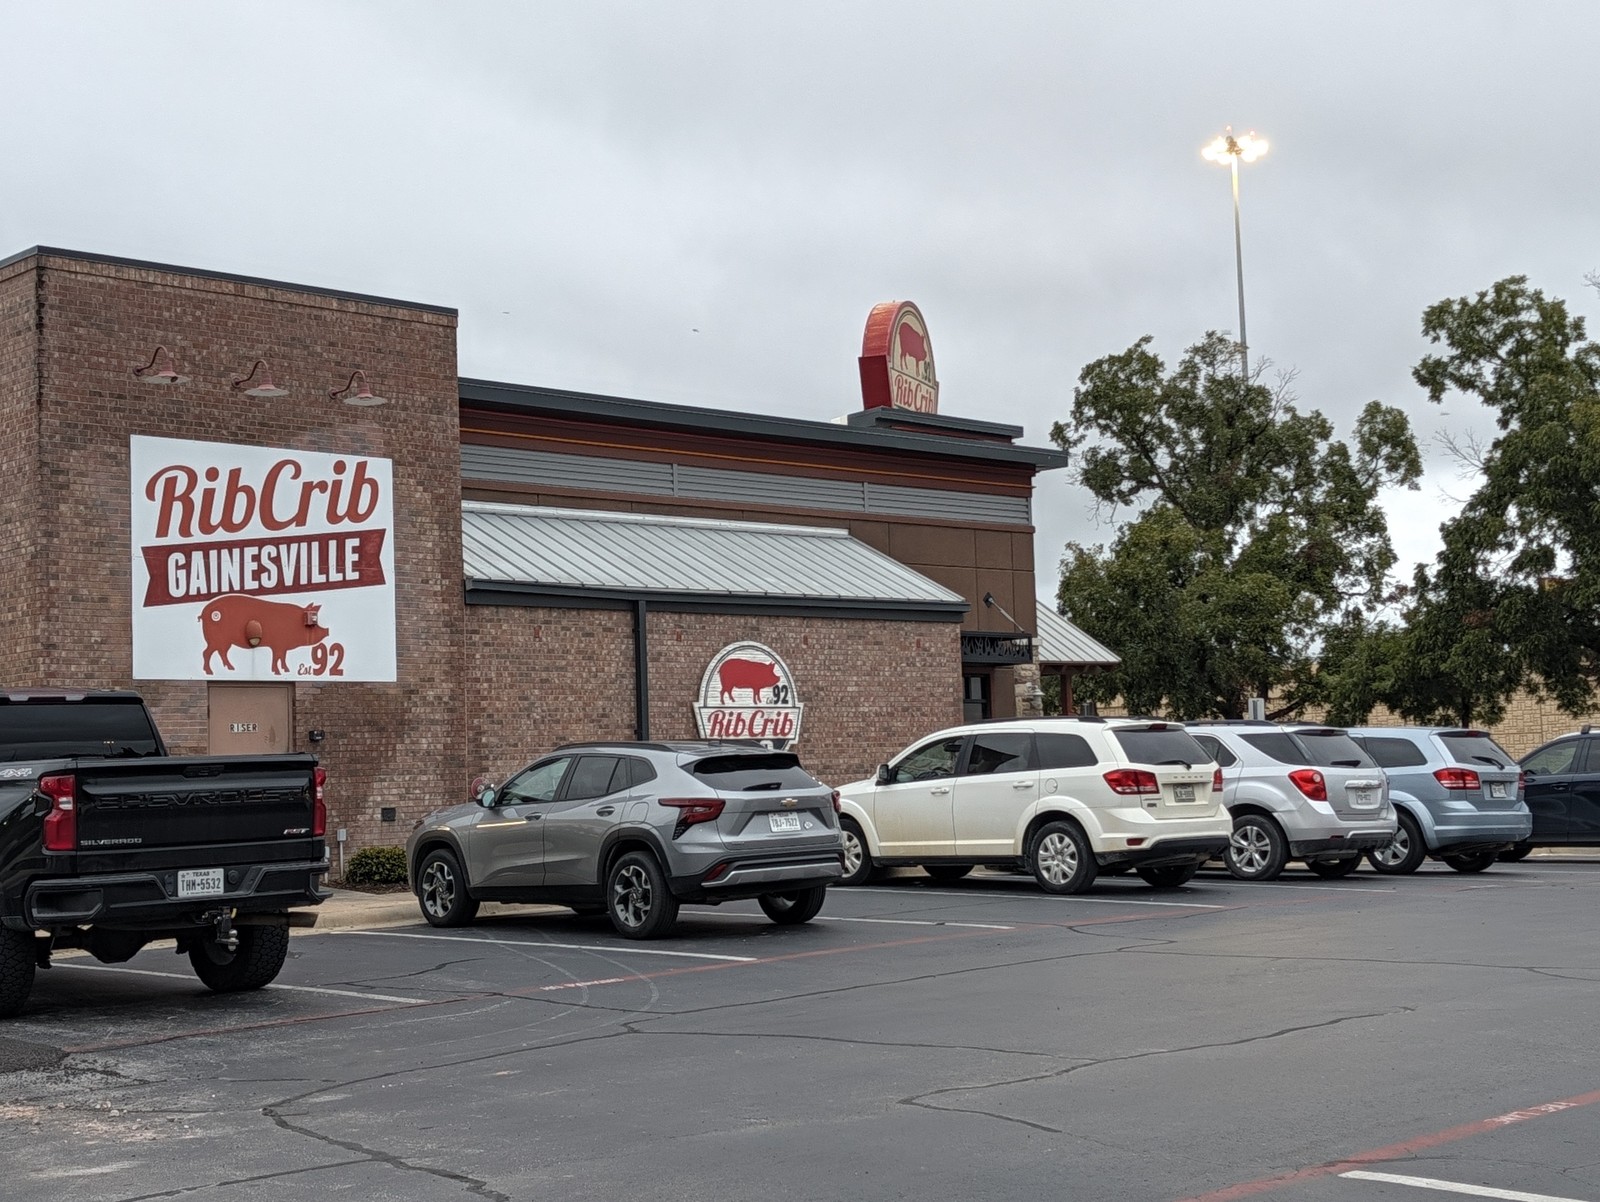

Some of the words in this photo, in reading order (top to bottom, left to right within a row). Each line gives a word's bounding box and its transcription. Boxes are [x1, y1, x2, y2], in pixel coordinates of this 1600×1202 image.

[145, 459, 379, 538] RibCrib
[167, 537, 360, 598] GAINESVILLE
[311, 642, 345, 677] 92
[772, 685, 789, 705] 92
[229, 723, 258, 732] RISER
[707, 710, 794, 738] RibCrib
[96, 788, 303, 810] CHEVROLET
[80, 837, 142, 846] SILVERADO
